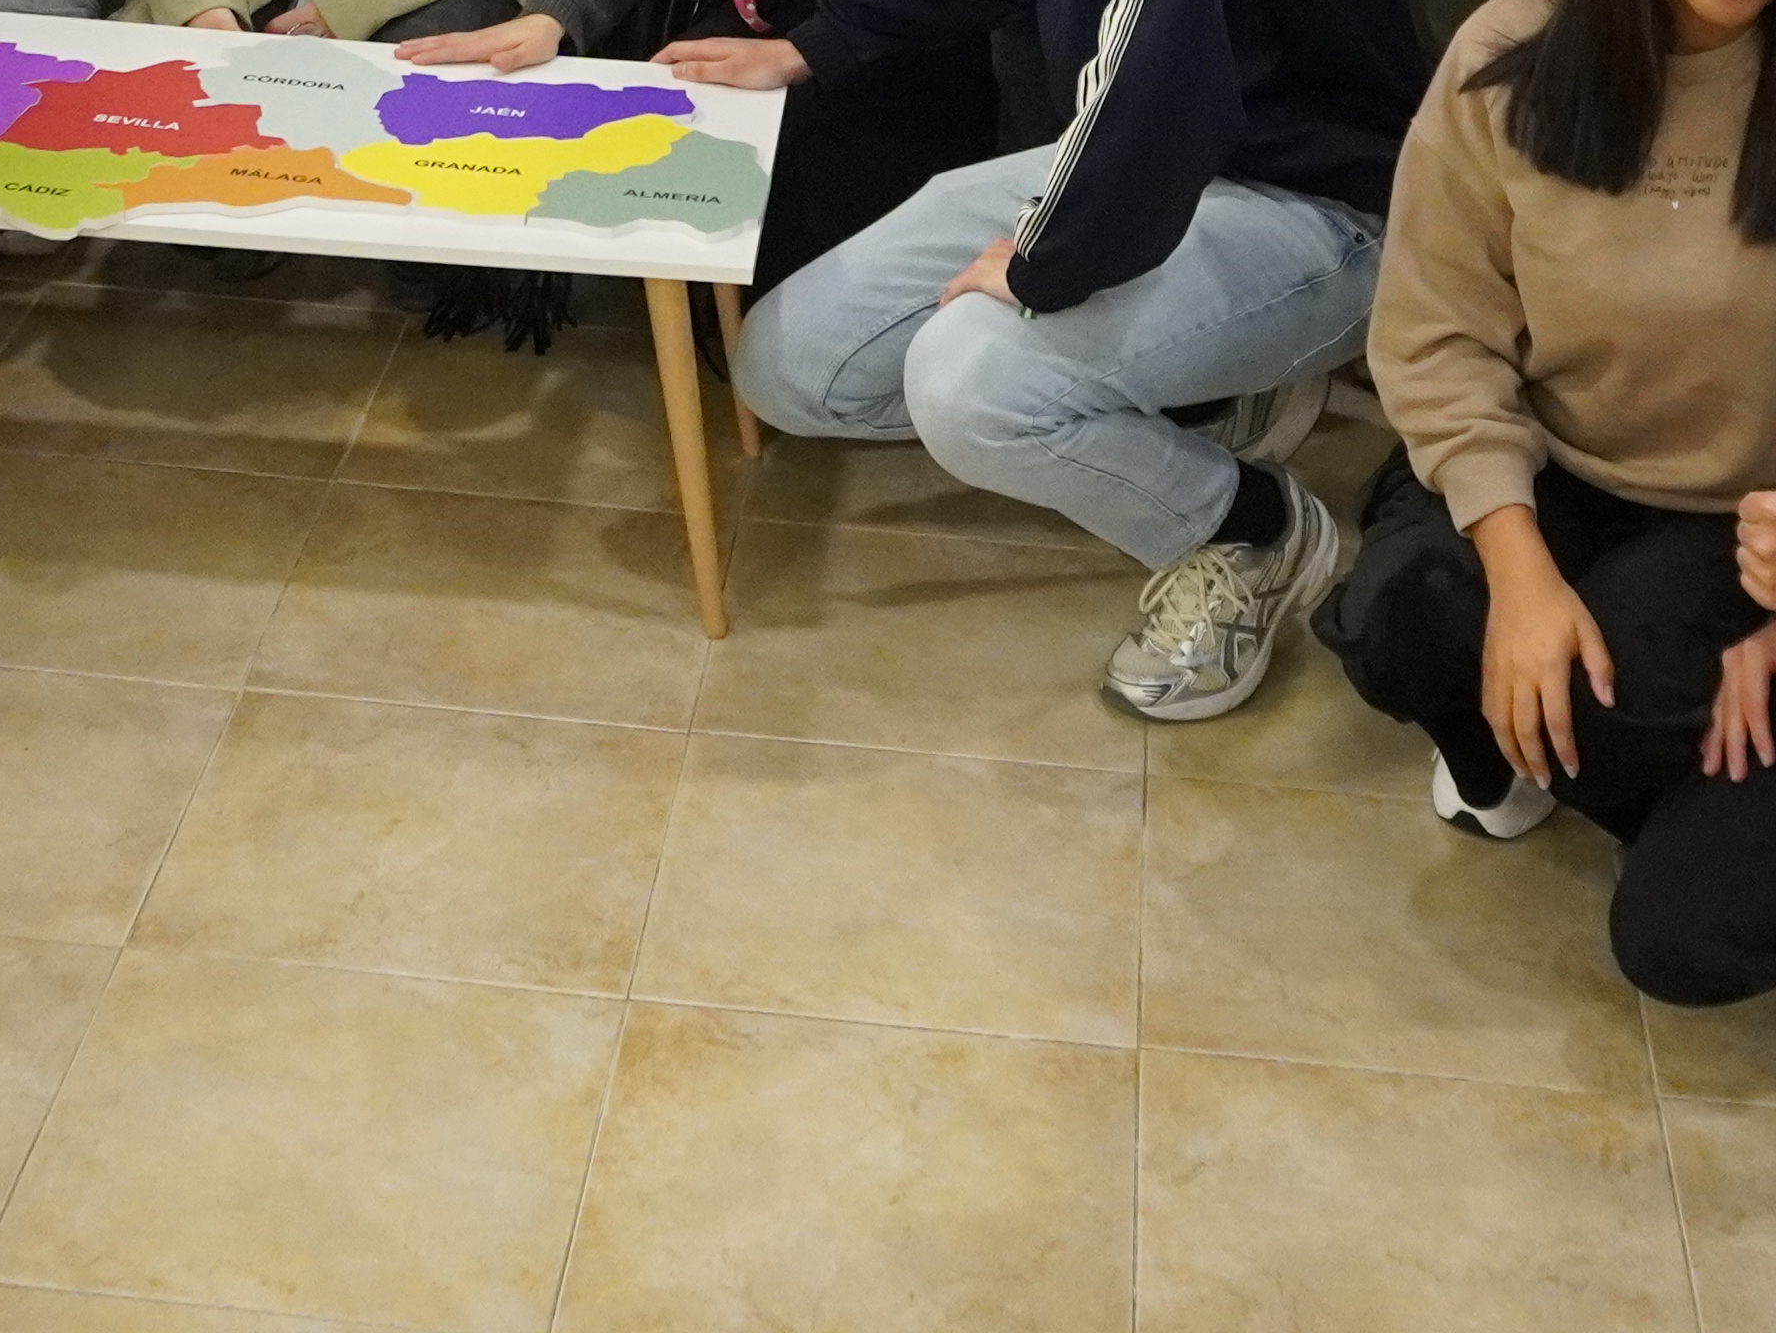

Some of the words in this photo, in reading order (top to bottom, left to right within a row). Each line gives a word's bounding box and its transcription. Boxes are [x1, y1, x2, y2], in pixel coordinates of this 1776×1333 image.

[243, 74, 345, 91] CÓRDOBA
[469, 105, 526, 118] JAÉN
[93, 113, 180, 130] SEVILLA
[414, 159, 522, 176] GRANADA
[229, 168, 323, 185] MÁLAGA
[623, 189, 721, 205] ALMERÍA
